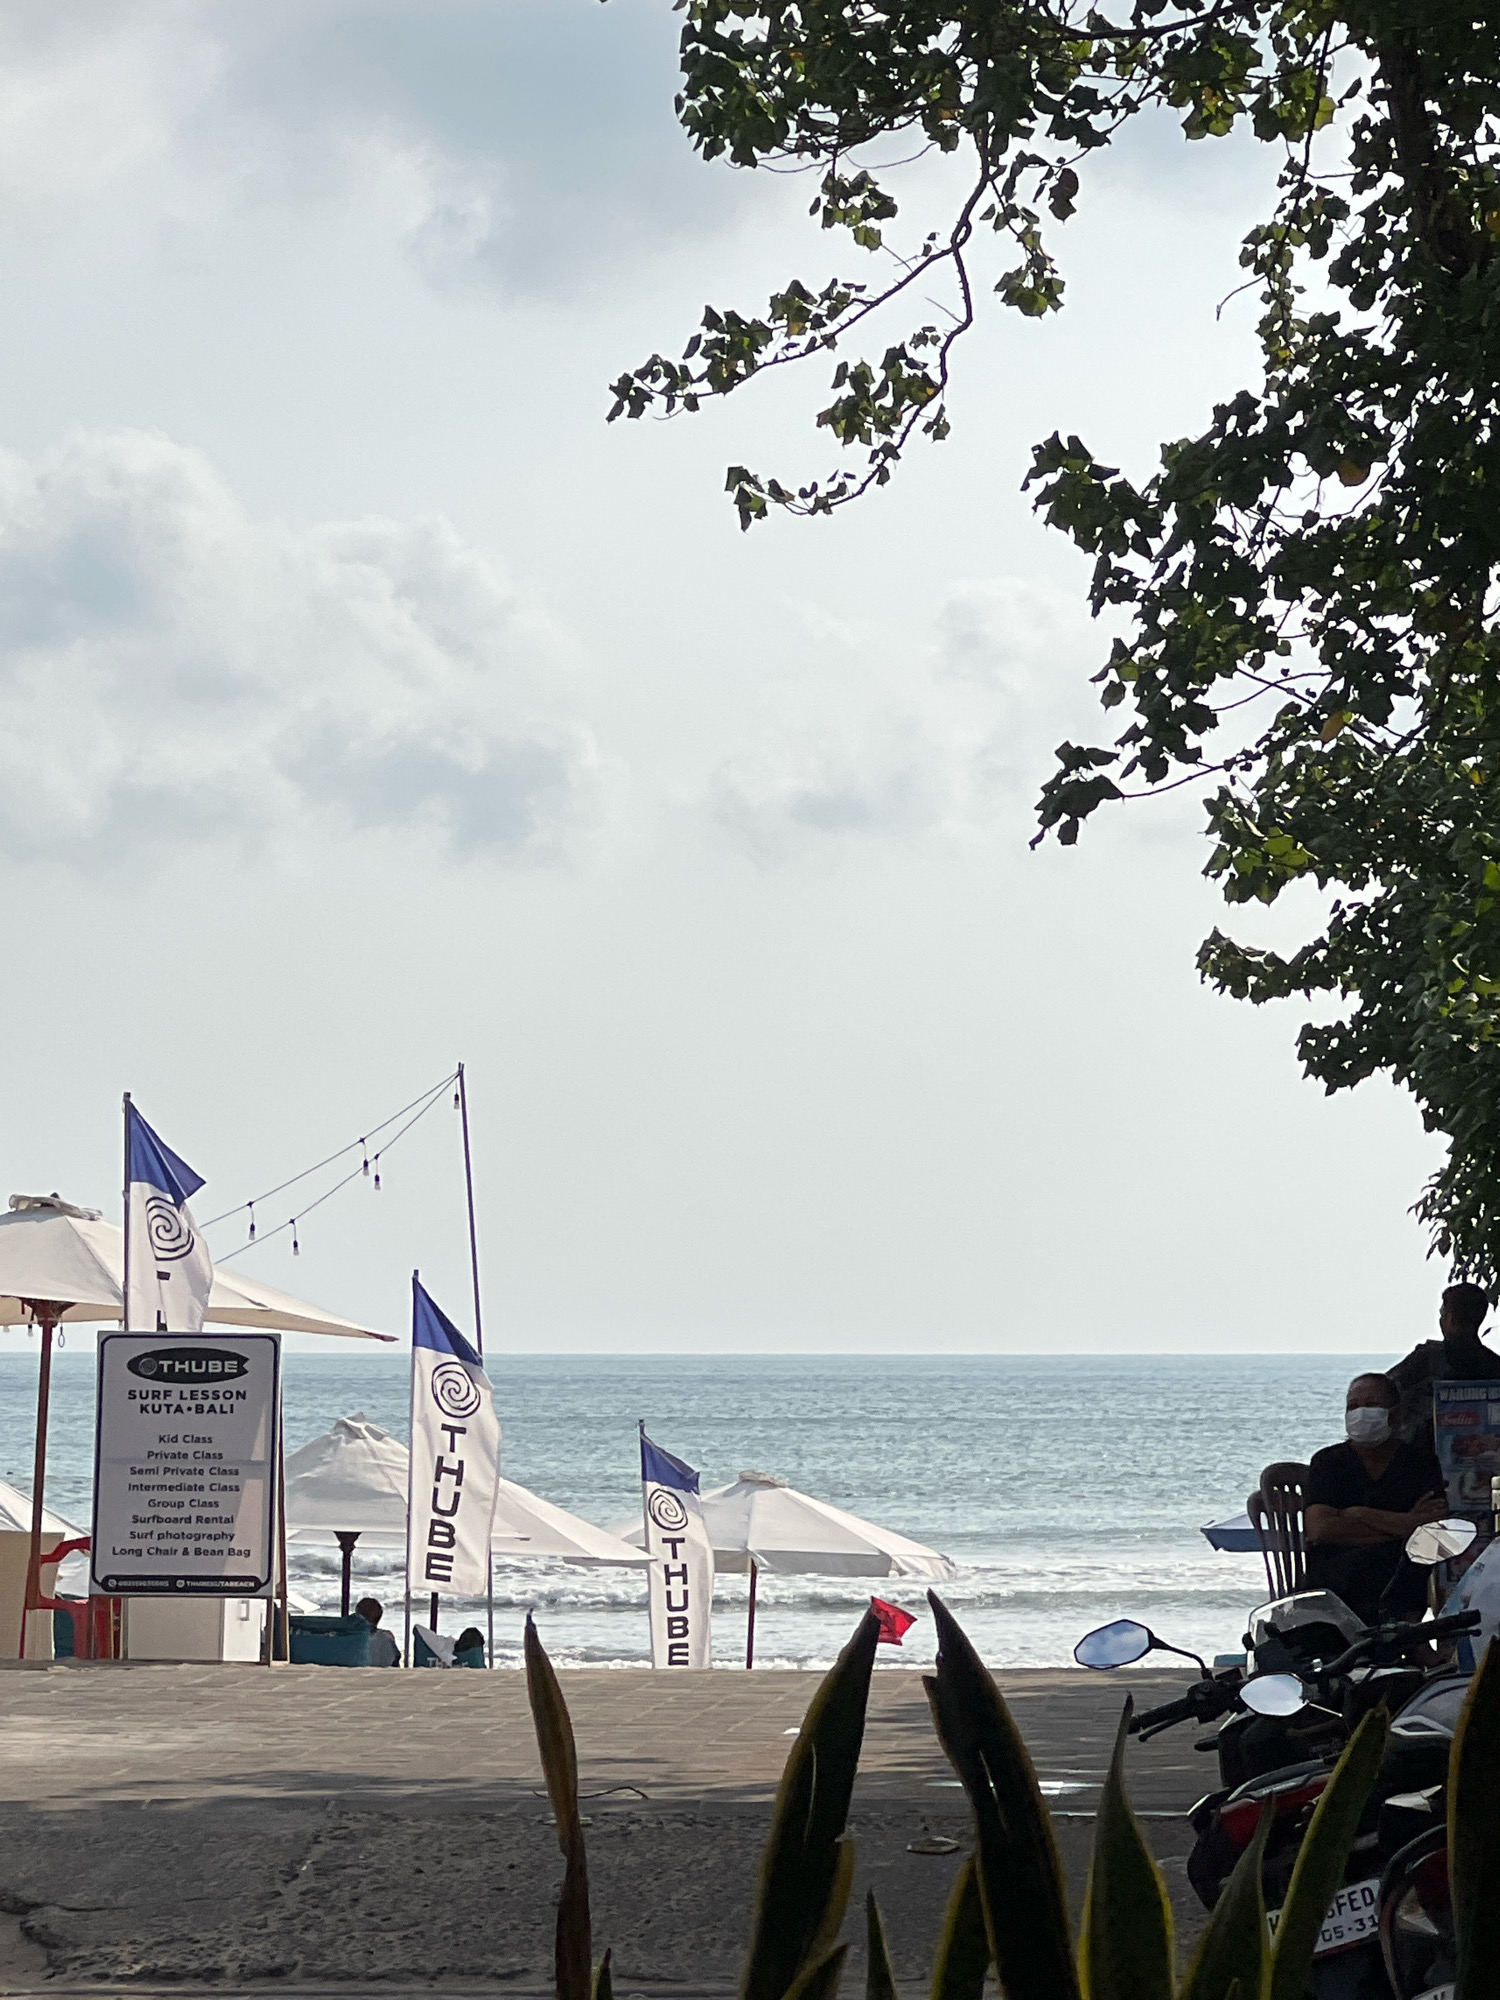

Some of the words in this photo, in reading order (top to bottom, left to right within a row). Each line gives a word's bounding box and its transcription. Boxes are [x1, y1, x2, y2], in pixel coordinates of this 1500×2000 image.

[158, 1360, 239, 1373] THUBE
[127, 1389, 173, 1400] SURF
[179, 1389, 247, 1401] LESSON
[158, 1434, 178, 1444] Kid
[182, 1434, 213, 1444] Class
[147, 1451, 189, 1460] Private
[192, 1451, 223, 1460] Class
[130, 1466, 159, 1476] Semi
[163, 1466, 204, 1476] Private
[208, 1467, 239, 1476] Class
[128, 1483, 205, 1492] Intermediate
[209, 1483, 240, 1492] Class
[147, 1499, 185, 1509] Group
[189, 1499, 219, 1508] Class
[425, 1423, 467, 1583] THUBE
[132, 1515, 192, 1524] Surfboard
[195, 1515, 234, 1524] Rental
[129, 1531, 154, 1540] Surf
[157, 1531, 235, 1541] photography
[112, 1547, 142, 1557] Long
[146, 1547, 178, 1556] Chair
[181, 1547, 190, 1556] &
[194, 1548, 224, 1556] Bean
[227, 1548, 251, 1558] Bag
[661, 1537, 689, 1666] THUBE
